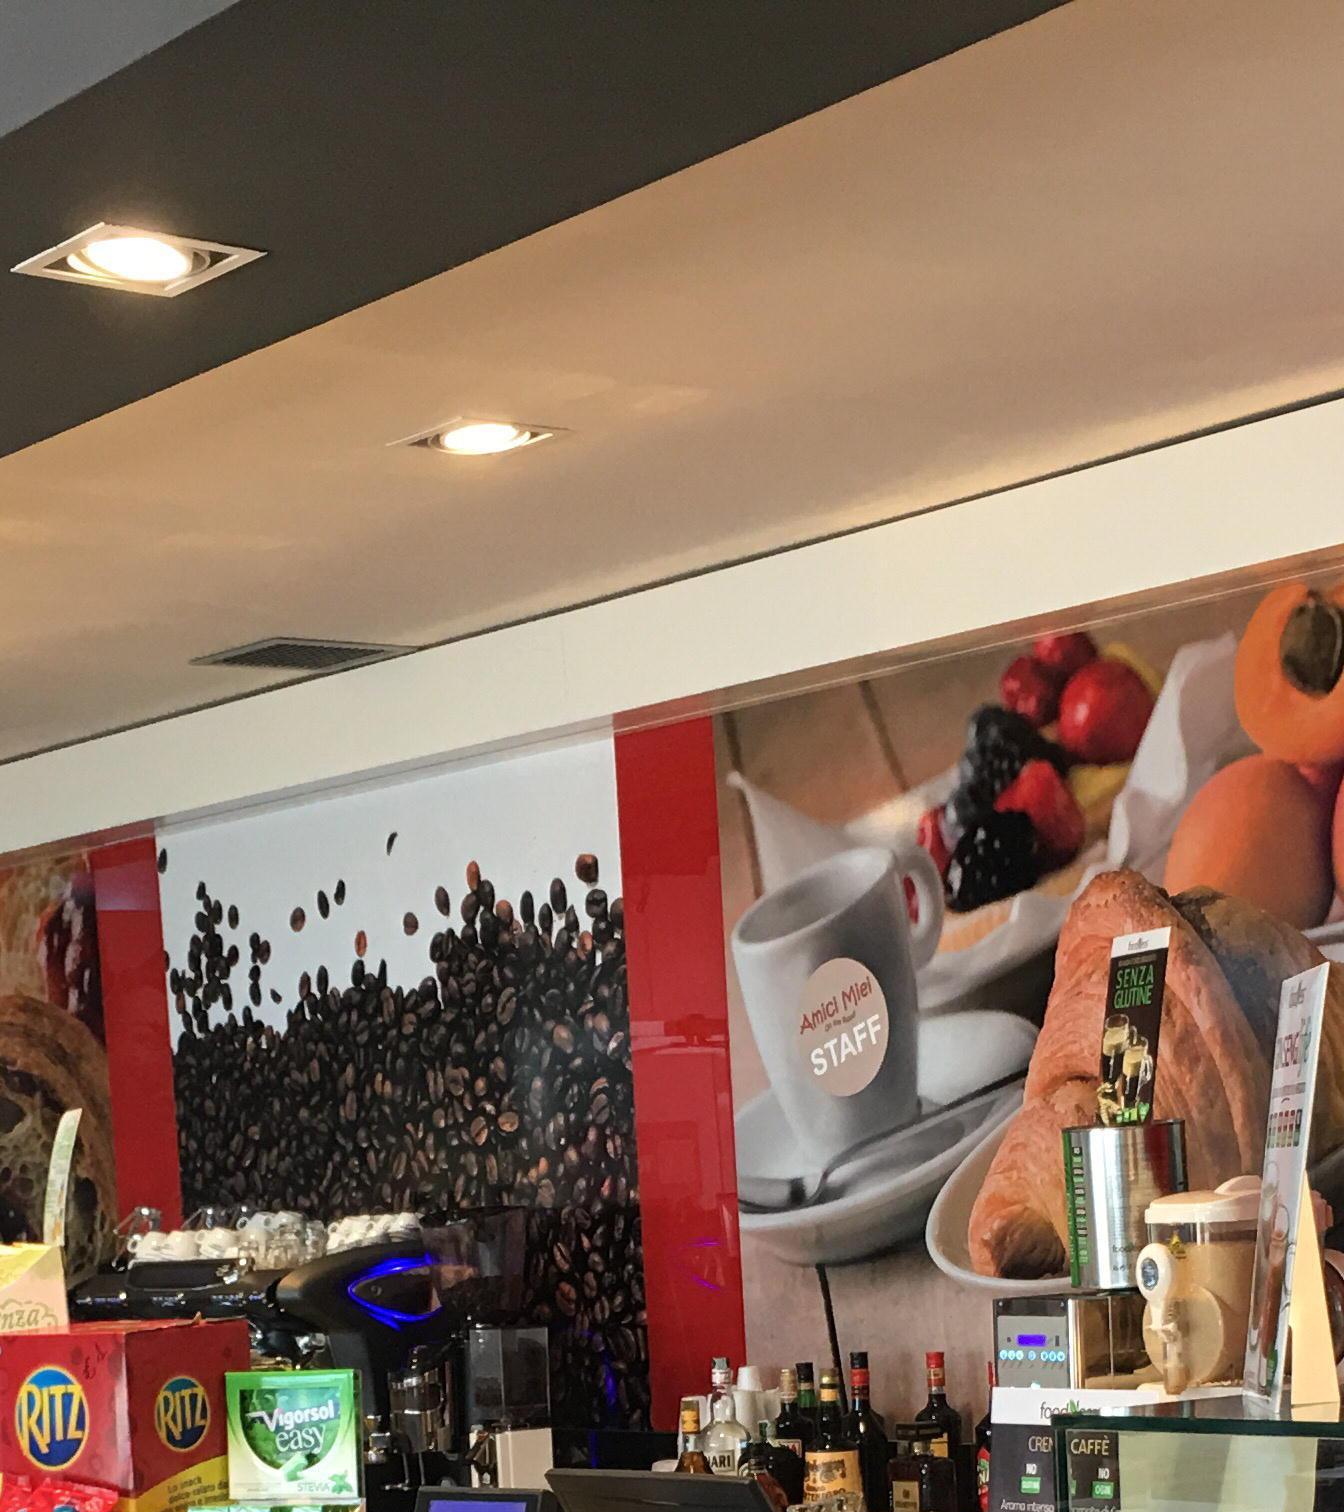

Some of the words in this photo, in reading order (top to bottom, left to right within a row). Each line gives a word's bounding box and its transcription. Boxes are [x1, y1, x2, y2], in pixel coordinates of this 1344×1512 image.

[1116, 964, 1154, 989] SENZA
[800, 996, 839, 1035] Amici
[841, 976, 872, 1011] Miei
[1114, 985, 1153, 1009] GLUTINE
[811, 1014, 881, 1076] STAFF
[19, 1384, 84, 1455] RITZ
[157, 1387, 207, 1441] RITZ
[246, 1400, 335, 1432] Vigorsol
[275, 1425, 326, 1454] easy
[1071, 1435, 1110, 1455] CAFFÈ
[297, 1480, 329, 1492] STEVIA
